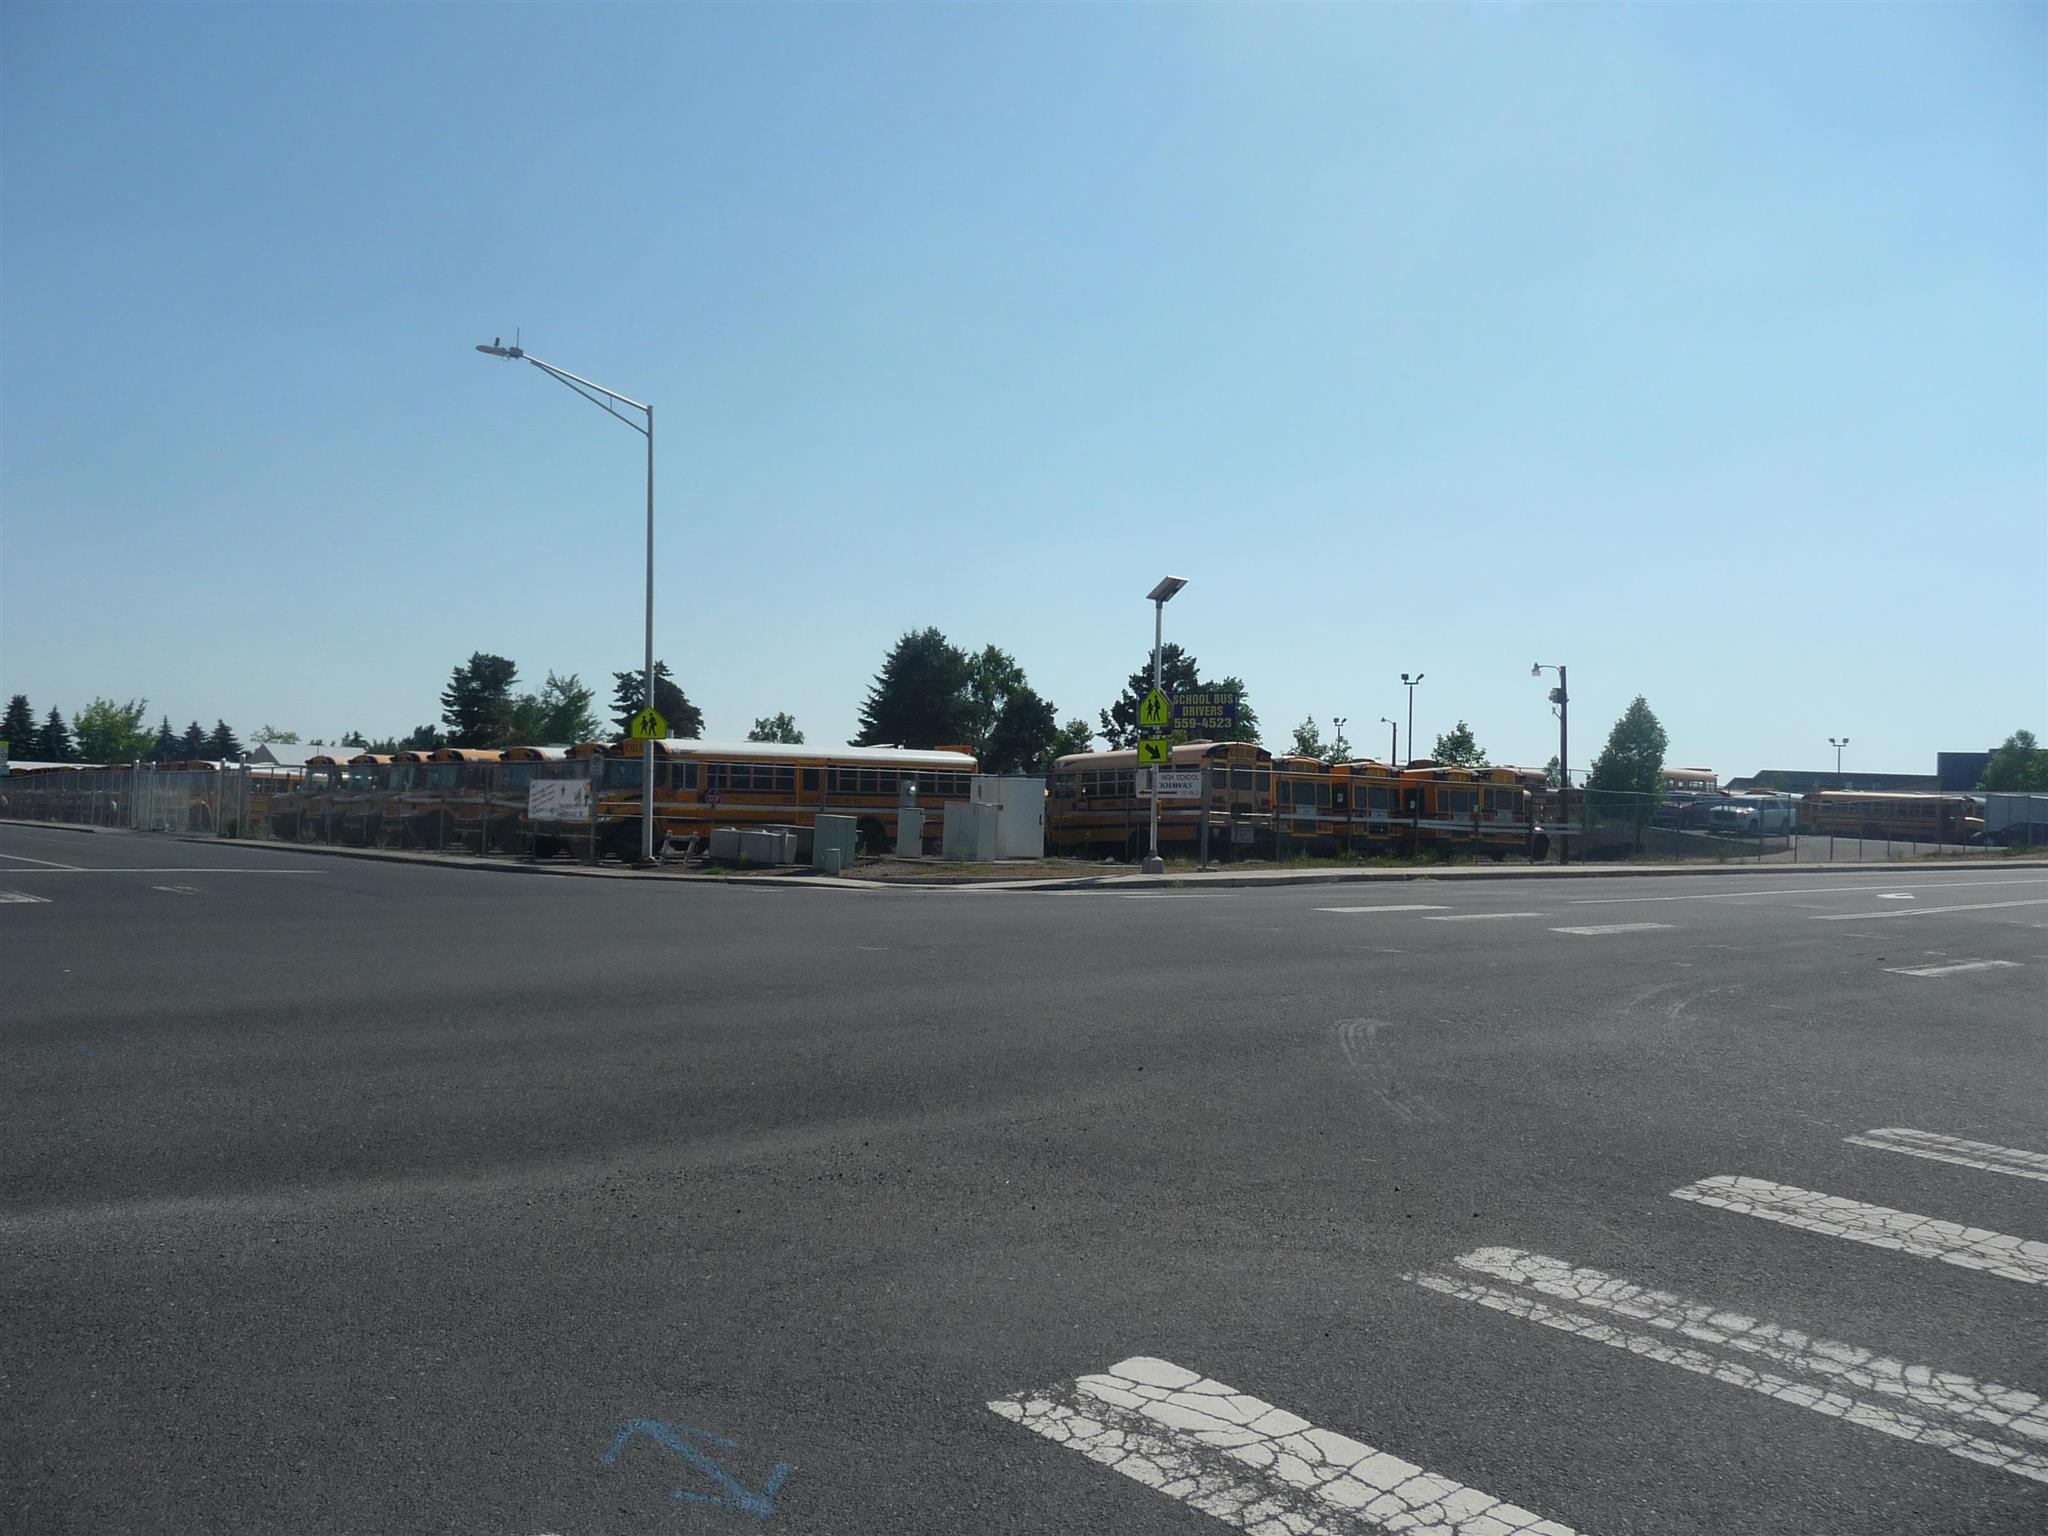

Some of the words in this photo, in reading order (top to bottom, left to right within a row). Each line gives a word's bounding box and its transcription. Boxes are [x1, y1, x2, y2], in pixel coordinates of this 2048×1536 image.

[1172, 693, 1211, 705] SCHOOL
[1213, 693, 1234, 705] BUS
[1182, 705, 1225, 717] DRIVERS
[1173, 717, 1233, 729] 559-4523
